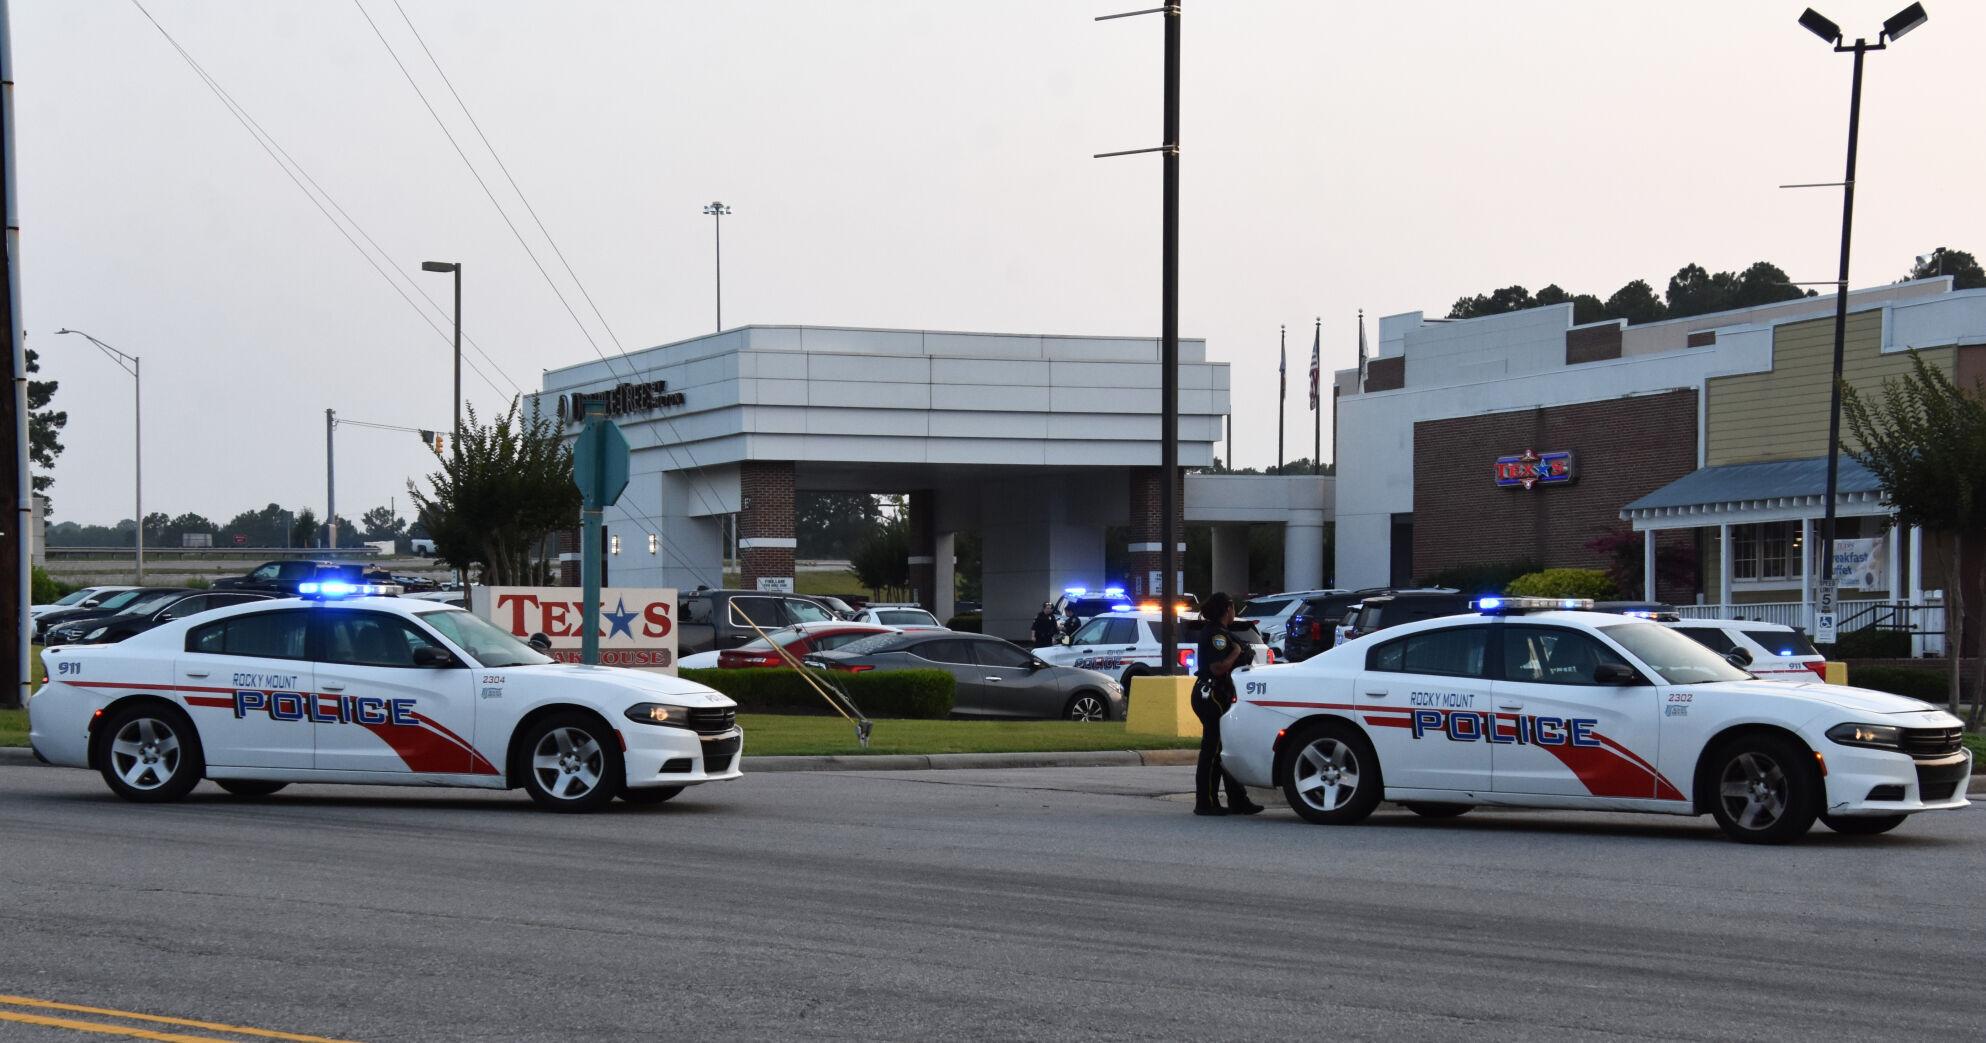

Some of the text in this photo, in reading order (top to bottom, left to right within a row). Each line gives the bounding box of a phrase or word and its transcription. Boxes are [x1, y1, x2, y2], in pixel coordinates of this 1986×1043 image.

[1493, 460, 1565, 479] TEXAS
[1822, 594, 1831, 605] 5
[58, 661, 81, 675] 911
[1788, 662, 1801, 670] 911
[232, 672, 298, 690] ROCKY MOUNT
[482, 675, 505, 684] 2304
[1246, 681, 1267, 695] 911
[1410, 691, 1475, 708] ROCKY MOUNT
[1668, 693, 1693, 702] 2302
[234, 689, 420, 726] POLICE
[1411, 709, 1601, 747] POLICE
